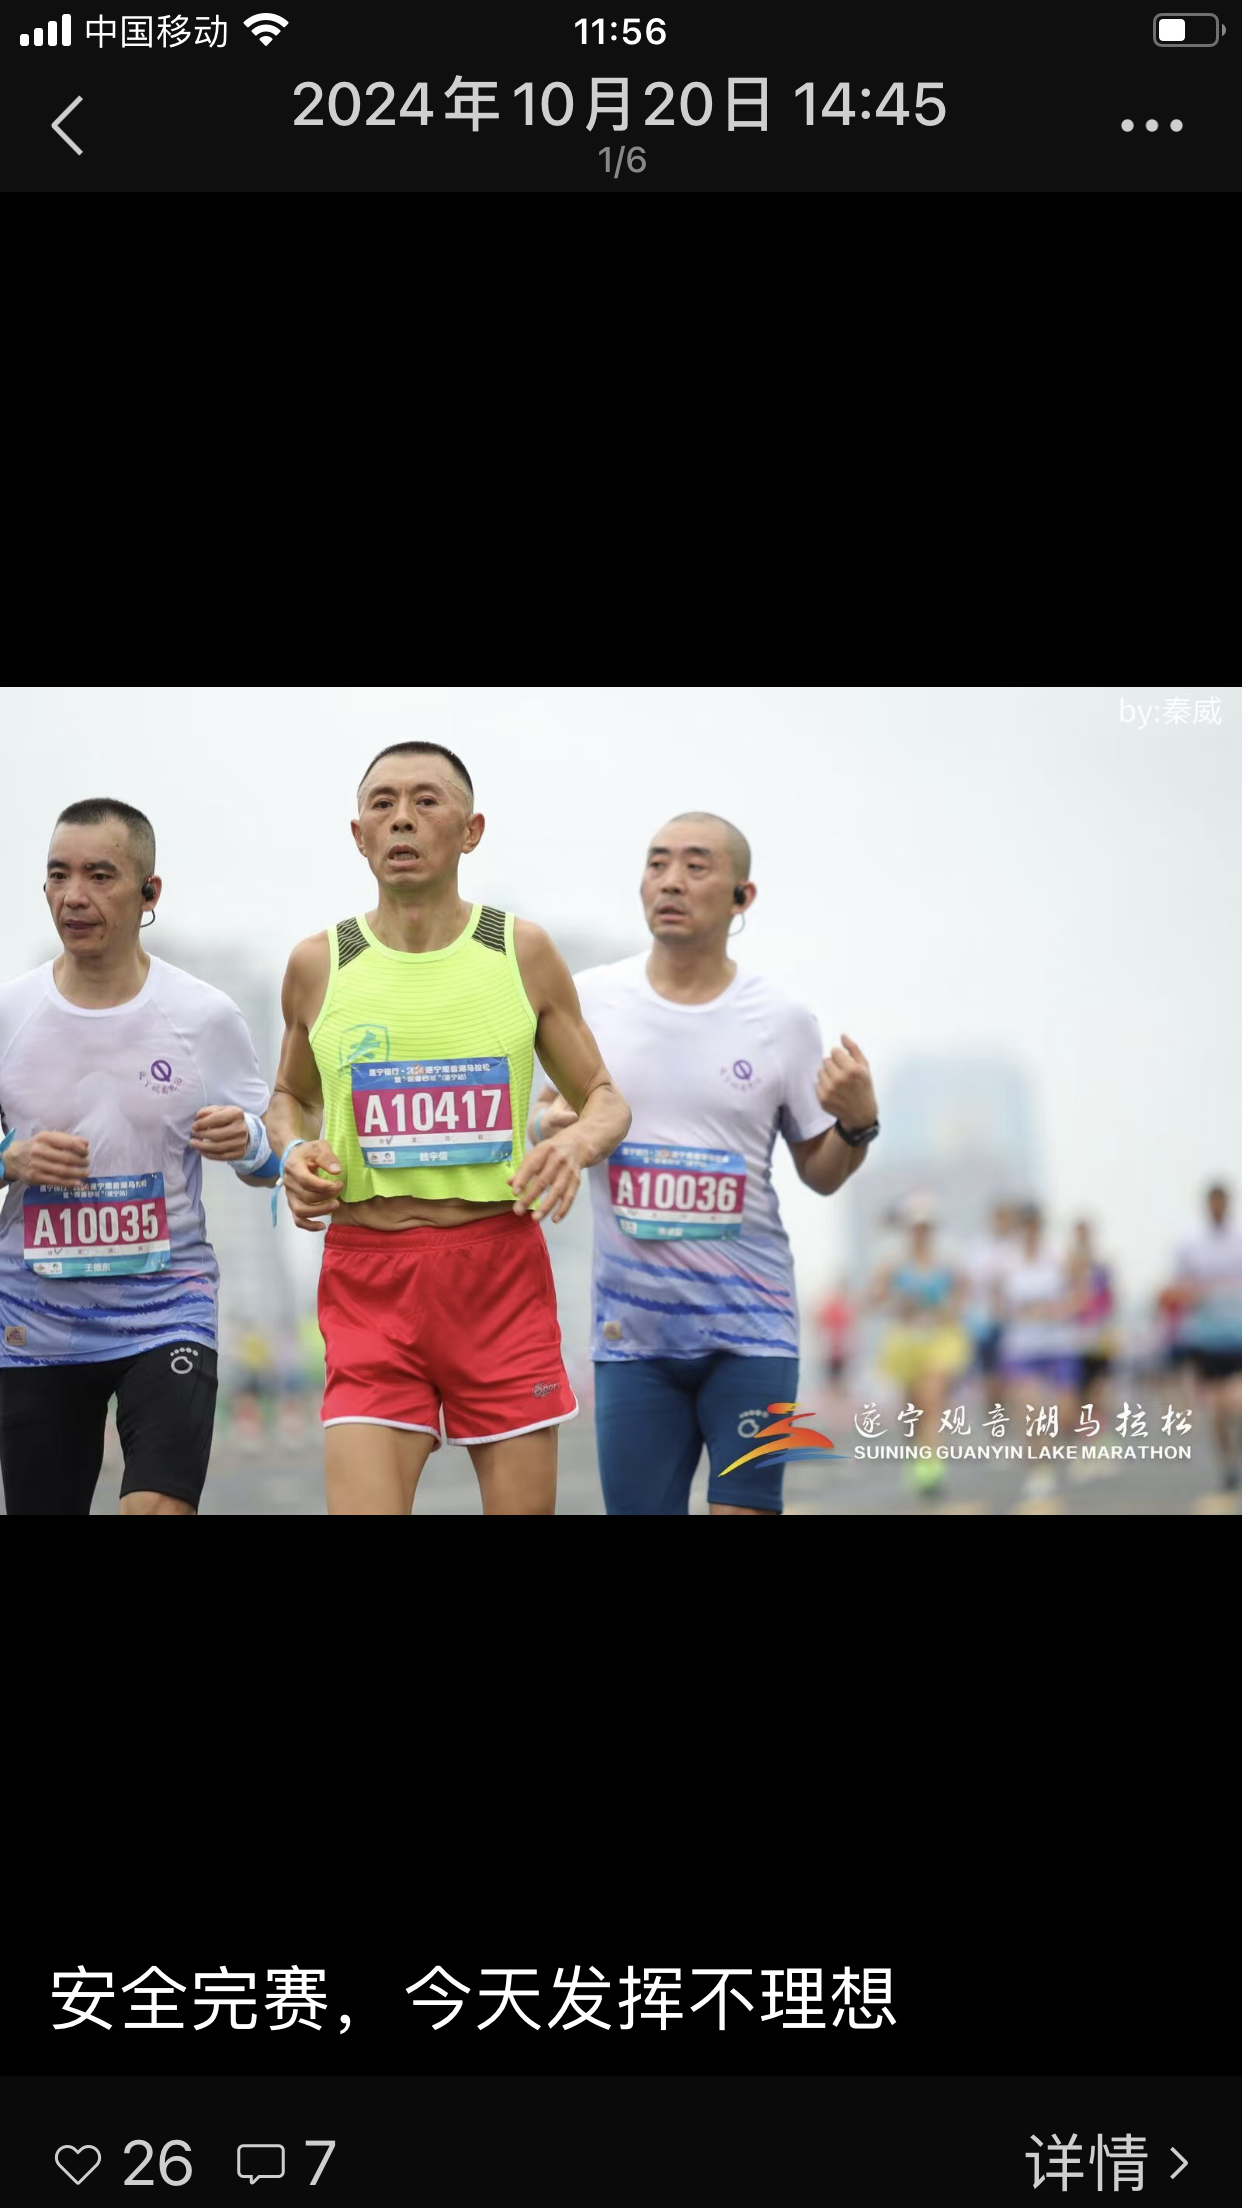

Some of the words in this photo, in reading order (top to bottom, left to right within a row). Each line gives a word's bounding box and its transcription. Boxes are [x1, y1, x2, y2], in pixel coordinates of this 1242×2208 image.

[364, 1089, 502, 1134] A10417
[617, 1170, 738, 1212] A10036
[33, 1202, 159, 1246] A10035
